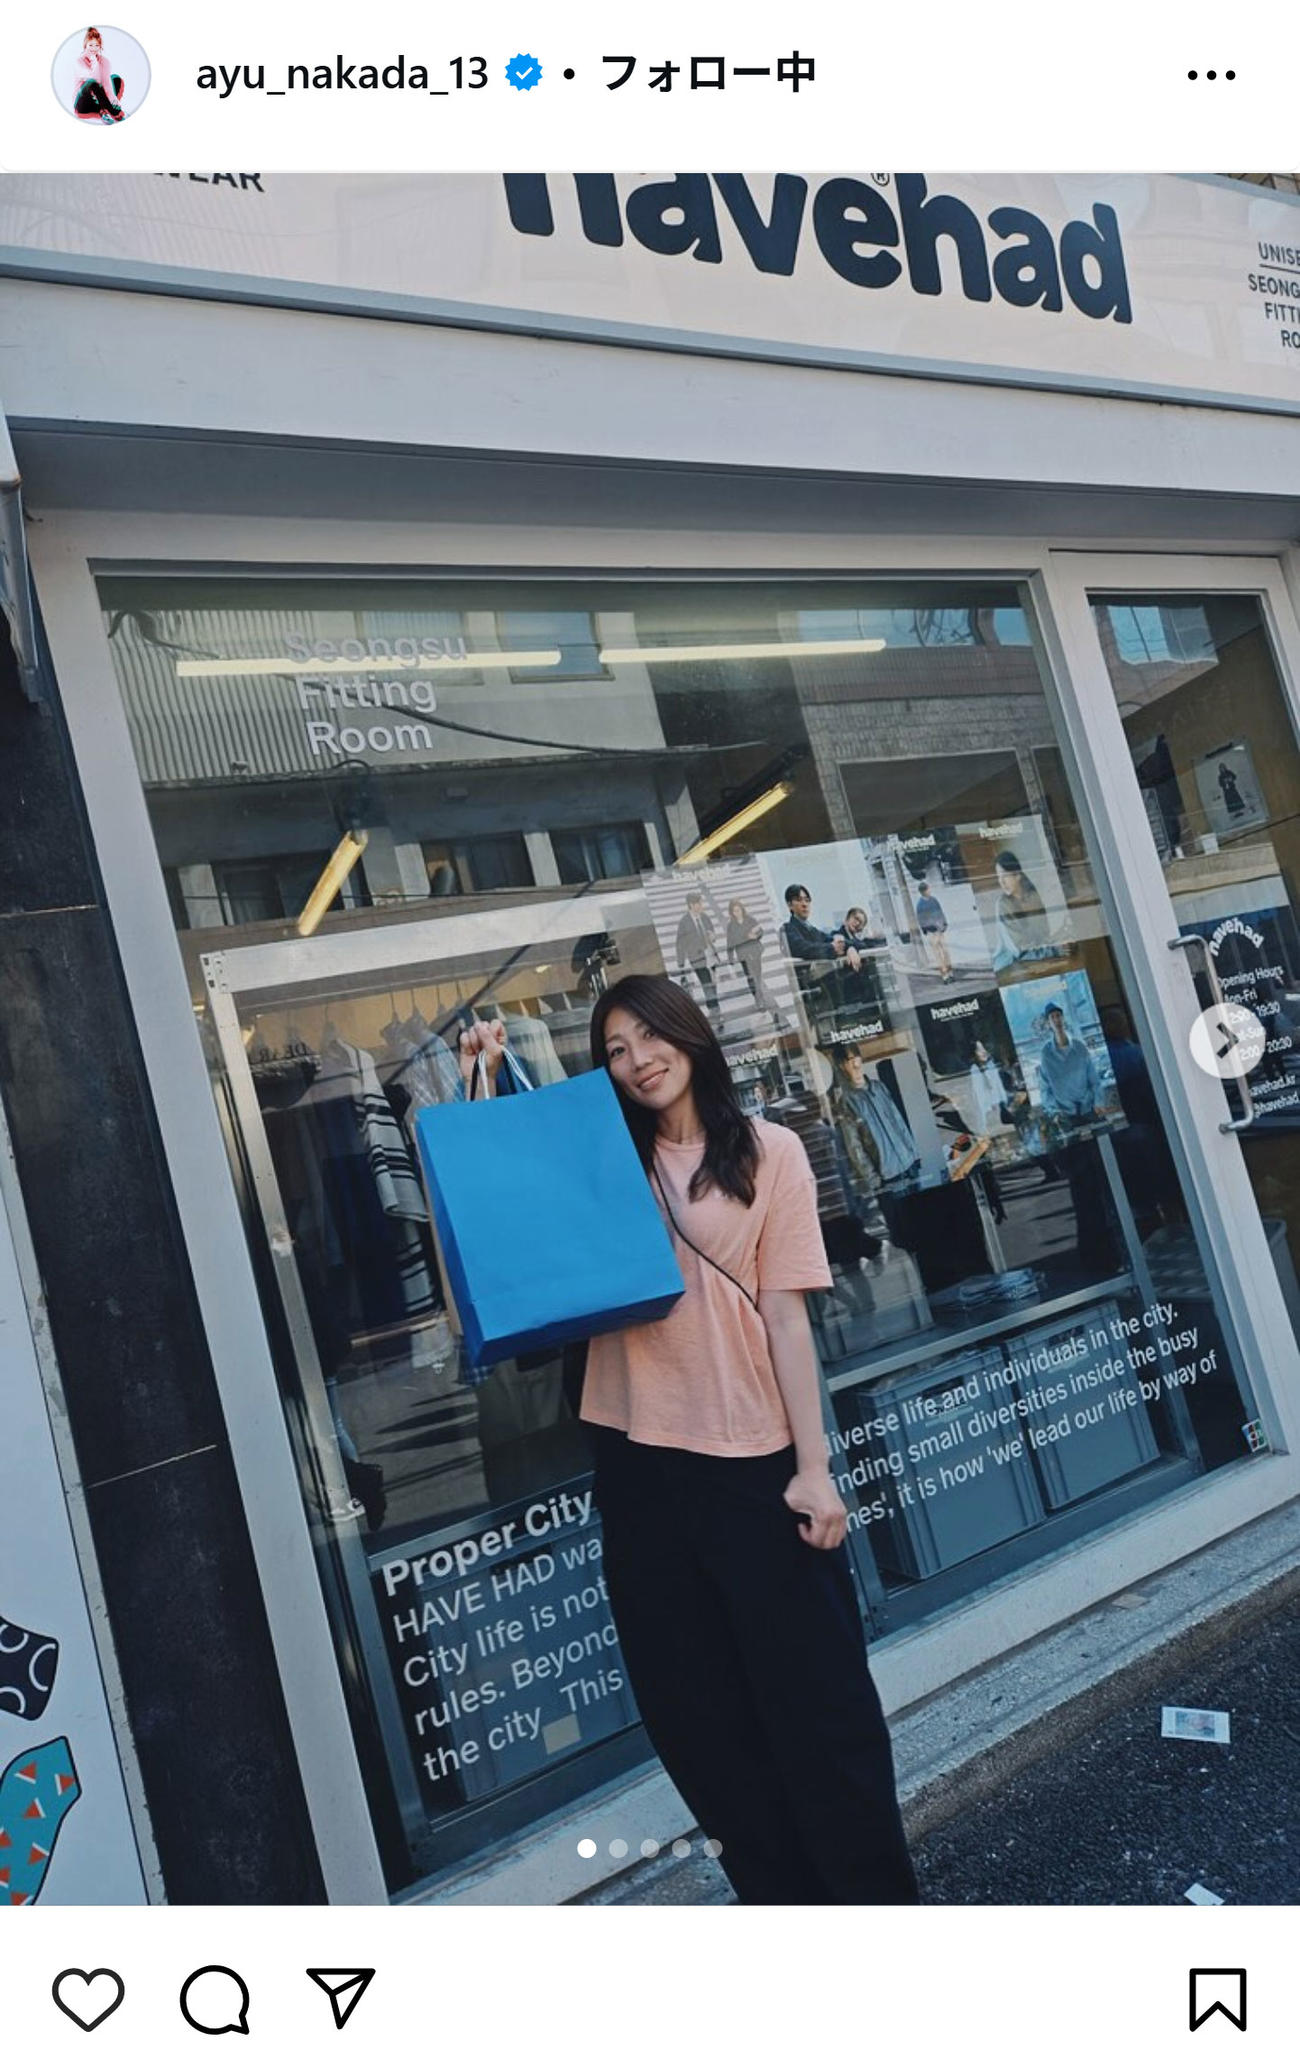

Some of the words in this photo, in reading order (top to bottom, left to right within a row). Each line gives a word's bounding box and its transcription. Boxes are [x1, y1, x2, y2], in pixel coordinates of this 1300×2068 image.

[1248, 273, 1300, 299] SEONG
[1281, 330, 1300, 349] RO
[284, 632, 467, 668] Seongsu
[296, 674, 438, 713] Fitting
[306, 721, 434, 755] Room
[1255, 966, 1284, 980] Hours
[931, 998, 980, 1020] havehad
[830, 1020, 884, 1042] havehad
[1249, 1074, 1296, 1097] avehad.kr
[902, 1396, 938, 1425] life
[942, 1374, 981, 1410] and
[983, 1337, 1088, 1392] individuals
[1089, 1328, 1109, 1349] in
[1110, 1317, 1140, 1340] the
[1144, 1303, 1178, 1328] city.
[908, 1421, 964, 1463] small
[968, 1381, 1067, 1437] diversities
[1070, 1357, 1126, 1395] inside
[1126, 1345, 1157, 1370] the
[1157, 1326, 1198, 1357] busy
[846, 1491, 895, 1533] nes',
[896, 1482, 915, 1508] it
[916, 1476, 937, 1500] is
[939, 1456, 985, 1490] how
[986, 1432, 1025, 1465] 'we'
[1028, 1413, 1071, 1450] lead
[1075, 1402, 1106, 1430] our
[1108, 1387, 1138, 1414] life
[1139, 1377, 1161, 1401] by
[1163, 1363, 1197, 1390] way
[1200, 1350, 1218, 1374] of
[382, 1521, 517, 1597] Proper
[524, 1490, 593, 1537] City
[393, 1581, 486, 1643] HAVE
[491, 1553, 555, 1601] HAD
[404, 1642, 468, 1687] City
[476, 1620, 524, 1657] life
[530, 1605, 556, 1632] is
[563, 1576, 610, 1618] not
[415, 1681, 505, 1736] rules.
[423, 1739, 480, 1782] the
[488, 1707, 541, 1751] city
[560, 1668, 624, 1712] This
